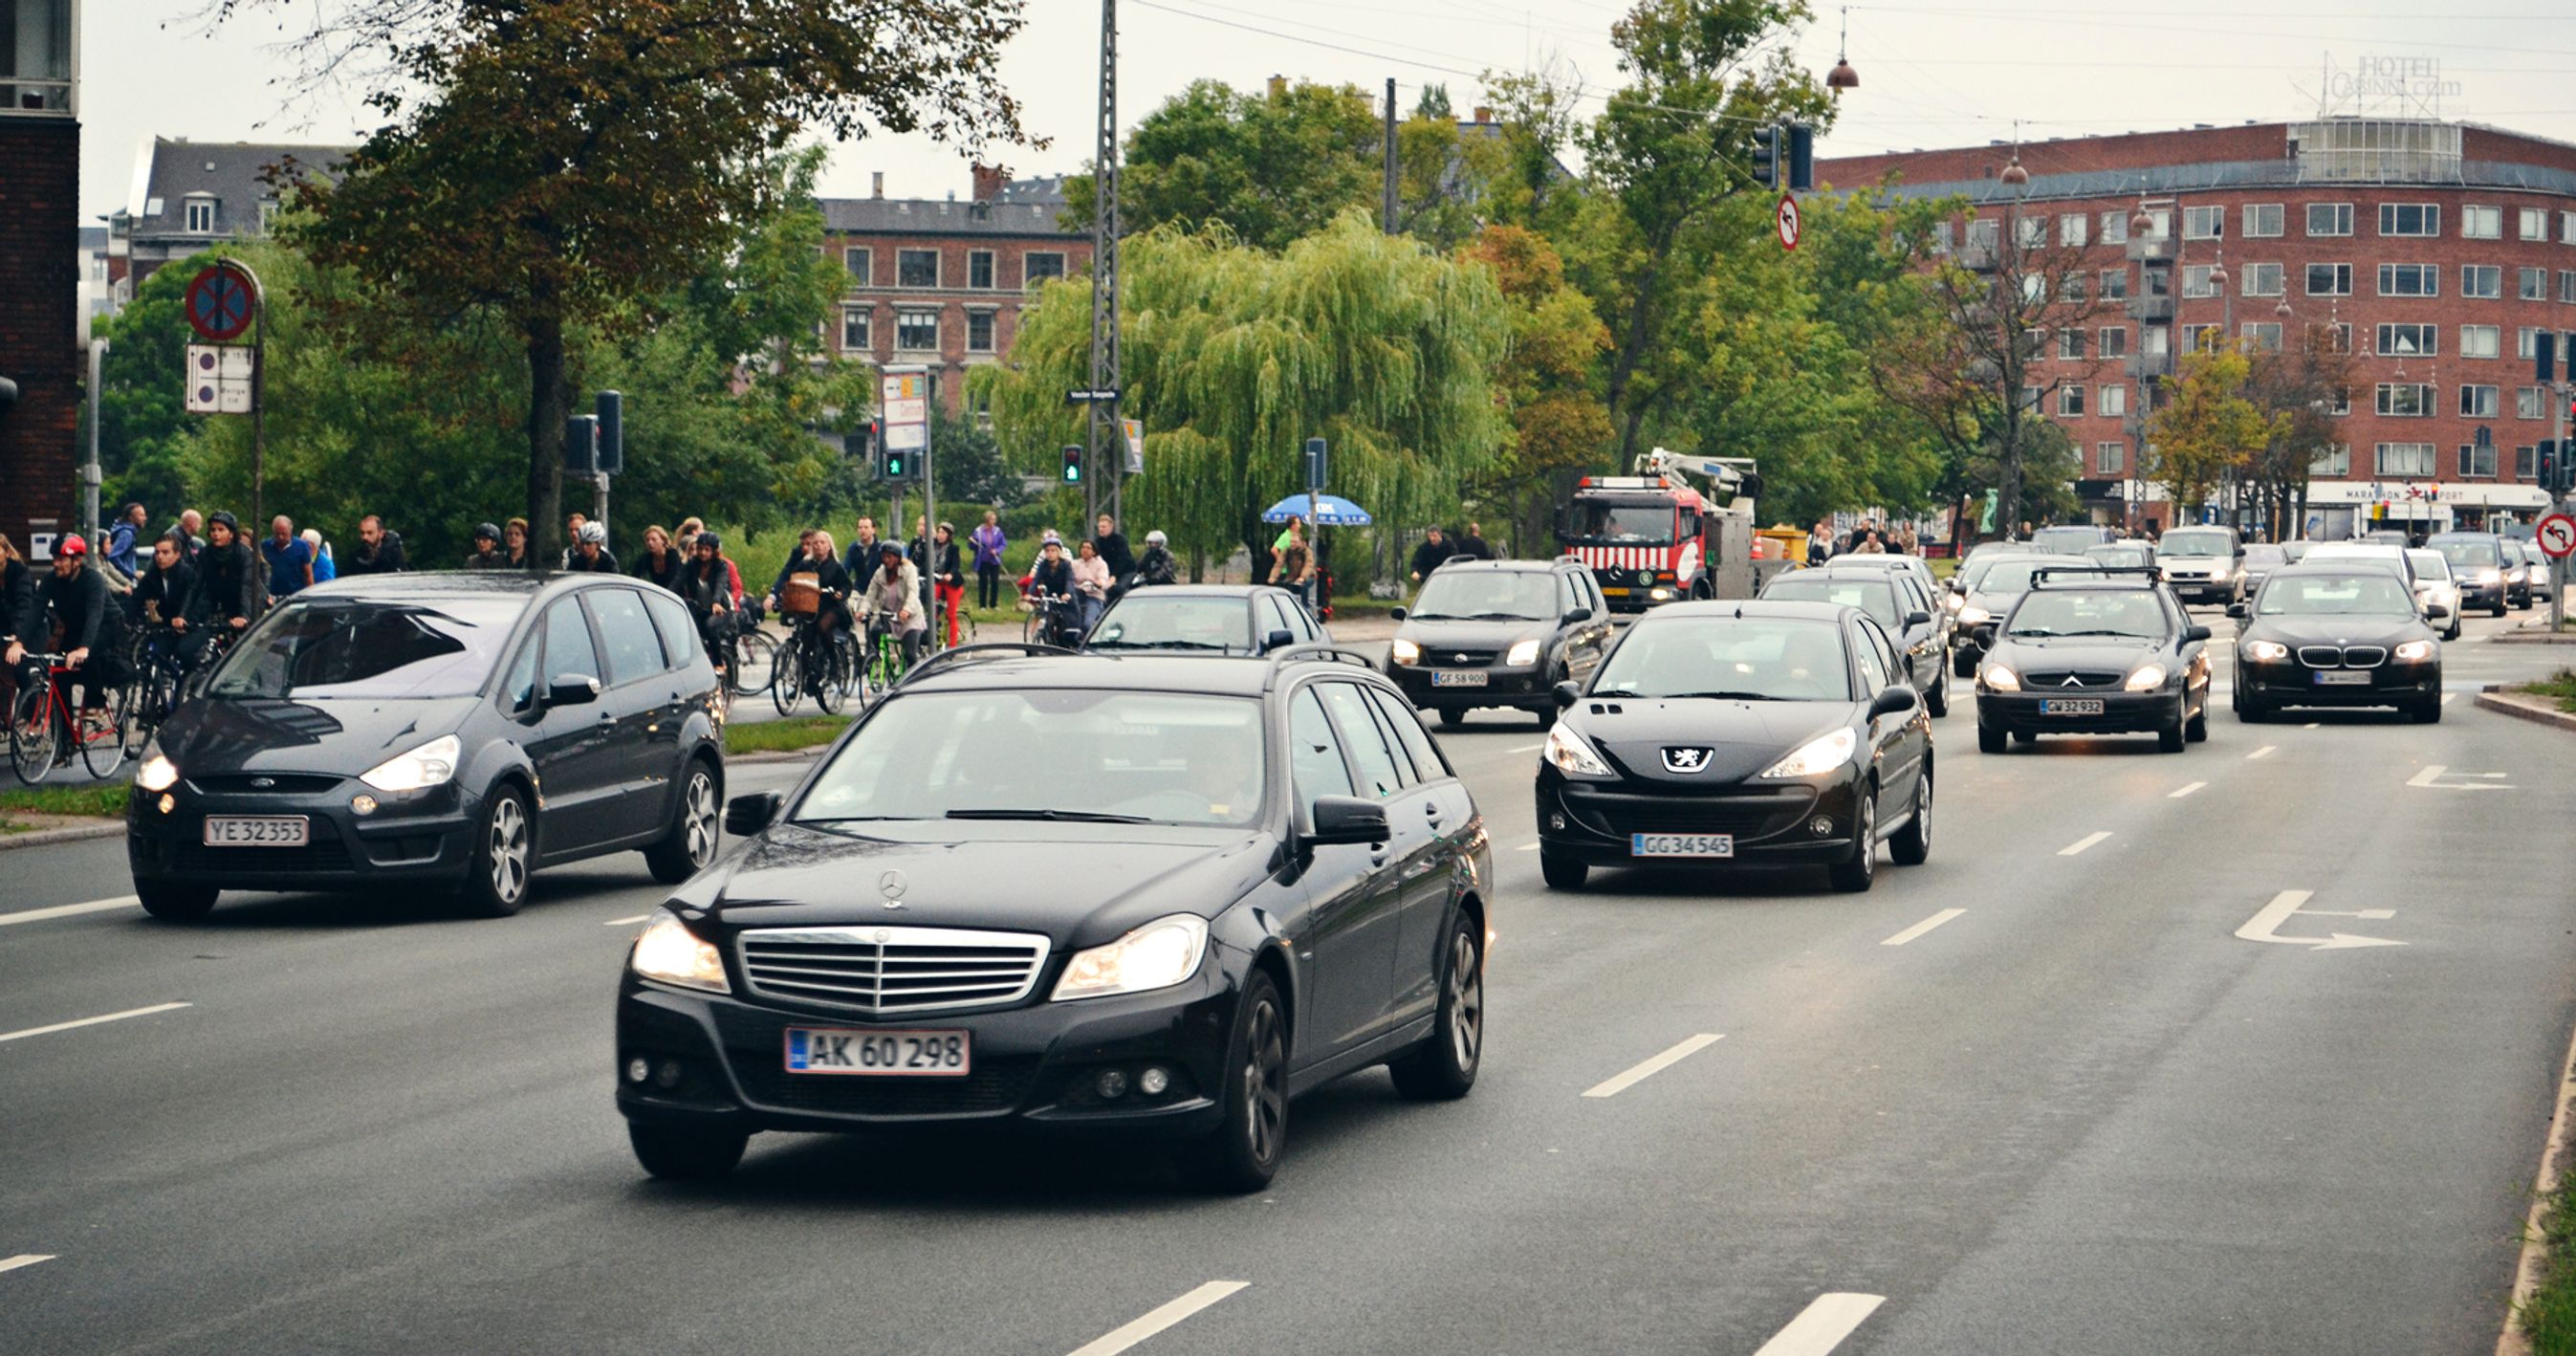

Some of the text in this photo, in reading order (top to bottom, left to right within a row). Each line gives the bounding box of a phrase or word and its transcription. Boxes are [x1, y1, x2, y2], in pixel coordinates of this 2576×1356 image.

[2360, 56, 2437, 77] HOTEL
[2347, 491, 2400, 500] MARAHON
[1439, 673, 1486, 684] GF 58 900
[2064, 701, 2079, 712] 32
[2080, 701, 2101, 712] 932
[210, 821, 303, 842] YE 32 353
[1645, 837, 1670, 854] GG
[1696, 837, 1731, 854] 545
[809, 1035, 964, 1067] AK 60 298
